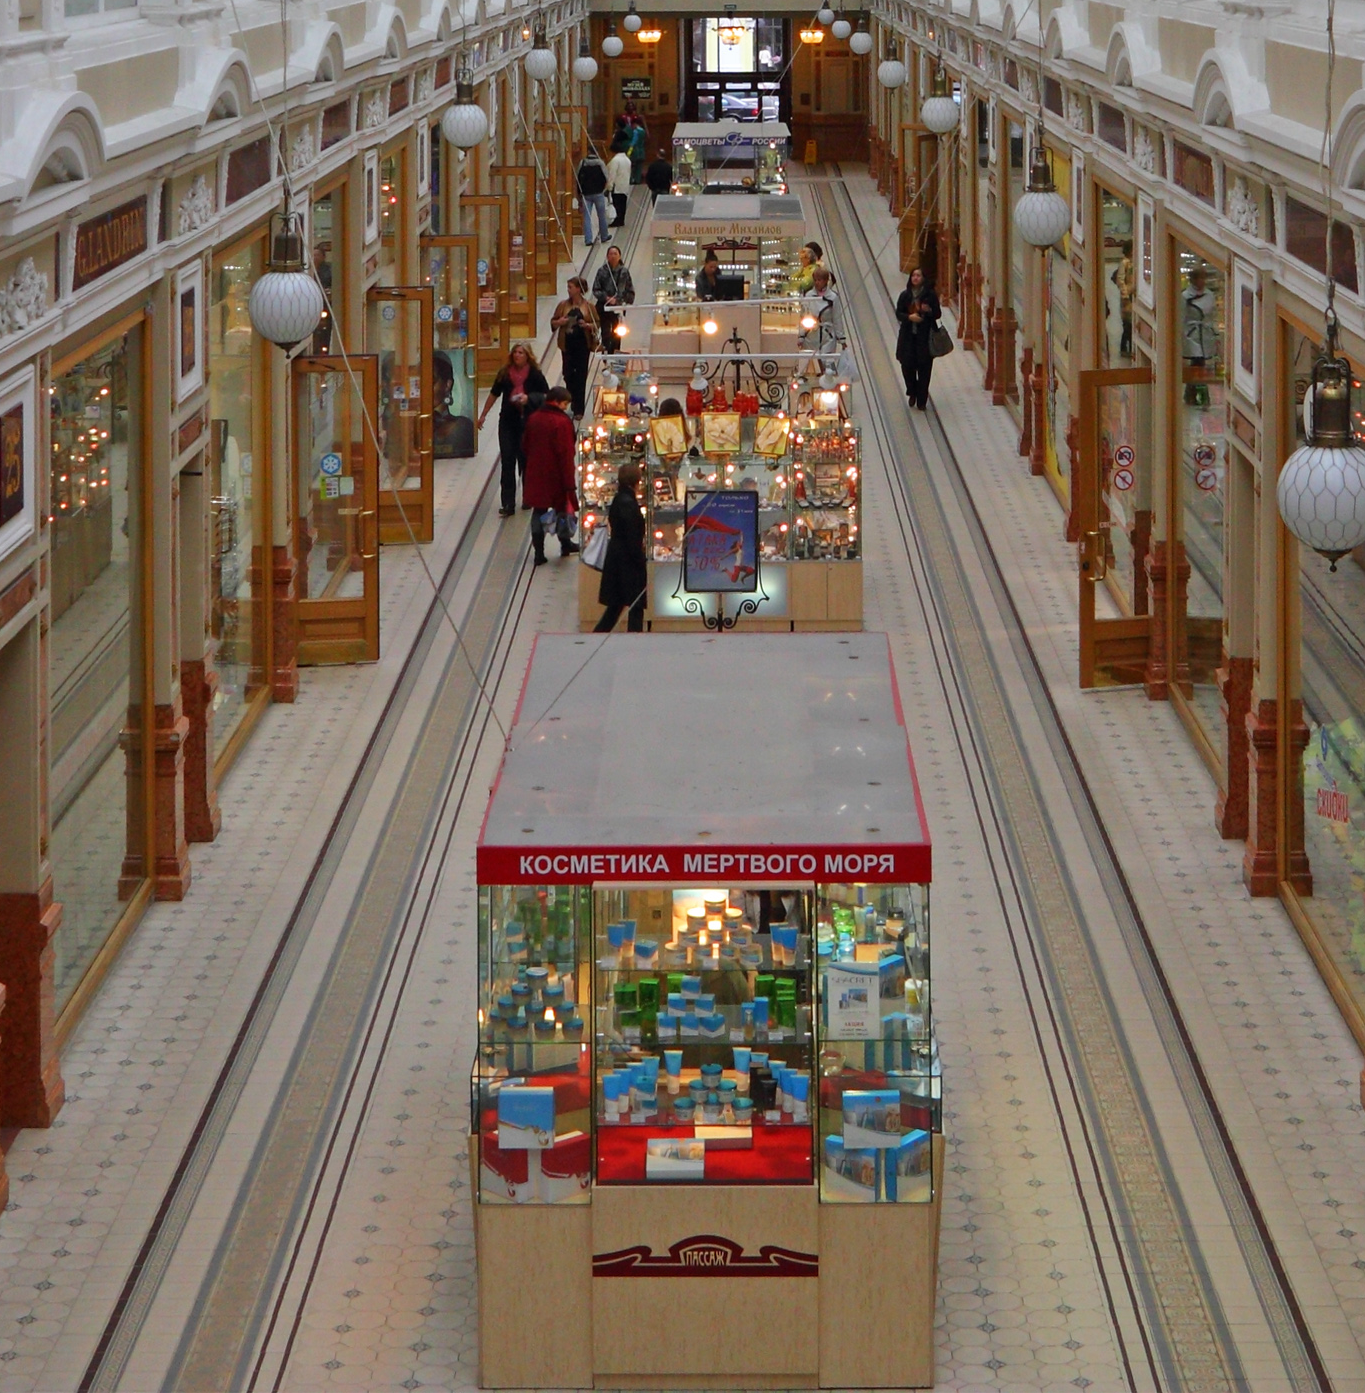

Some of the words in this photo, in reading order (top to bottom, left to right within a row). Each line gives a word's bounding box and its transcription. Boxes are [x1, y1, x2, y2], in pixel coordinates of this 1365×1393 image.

[5, 431, 22, 498] 25
[519, 854, 670, 875] КОСМЕТИКА
[683, 853, 818, 874] МЕРТВОГО
[823, 853, 895, 874] МОРЯ
[686, 1250, 725, 1267] ПАССАЖ
